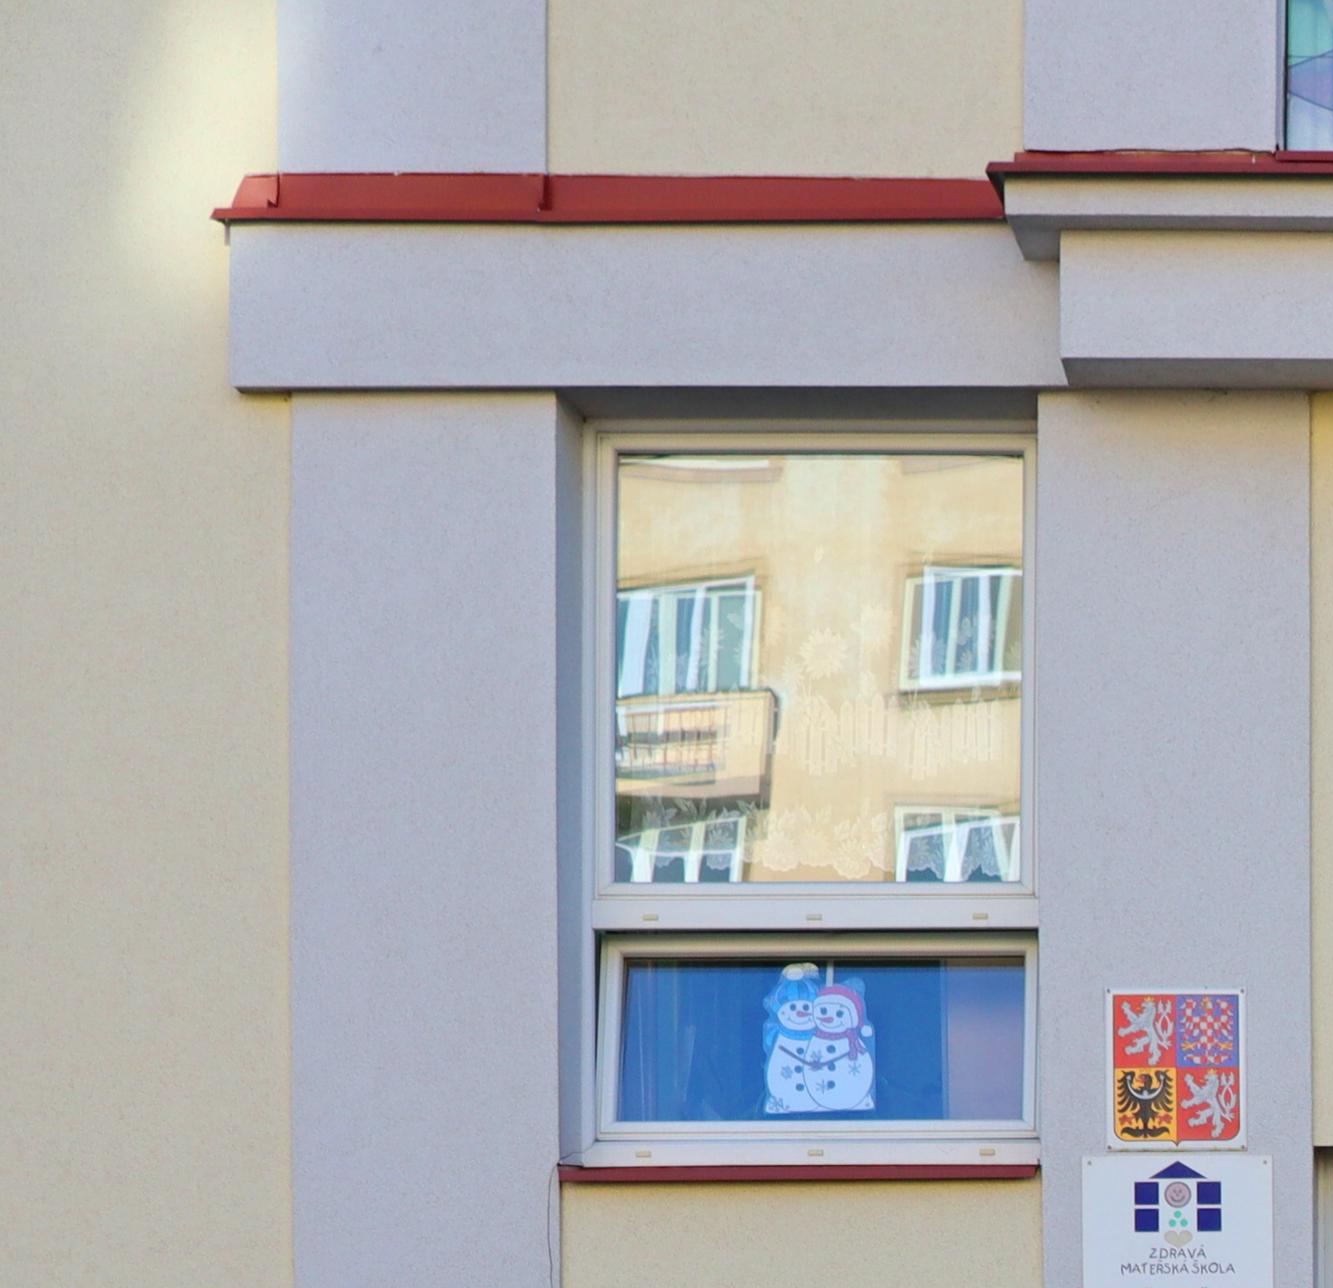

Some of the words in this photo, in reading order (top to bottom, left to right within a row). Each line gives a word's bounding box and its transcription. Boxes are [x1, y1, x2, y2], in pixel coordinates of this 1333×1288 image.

[1148, 1244, 1207, 1259] ZDRAVÁ
[1120, 1260, 1189, 1275] MATEŘSKÁ
[1191, 1260, 1236, 1274] ŠKOLA
